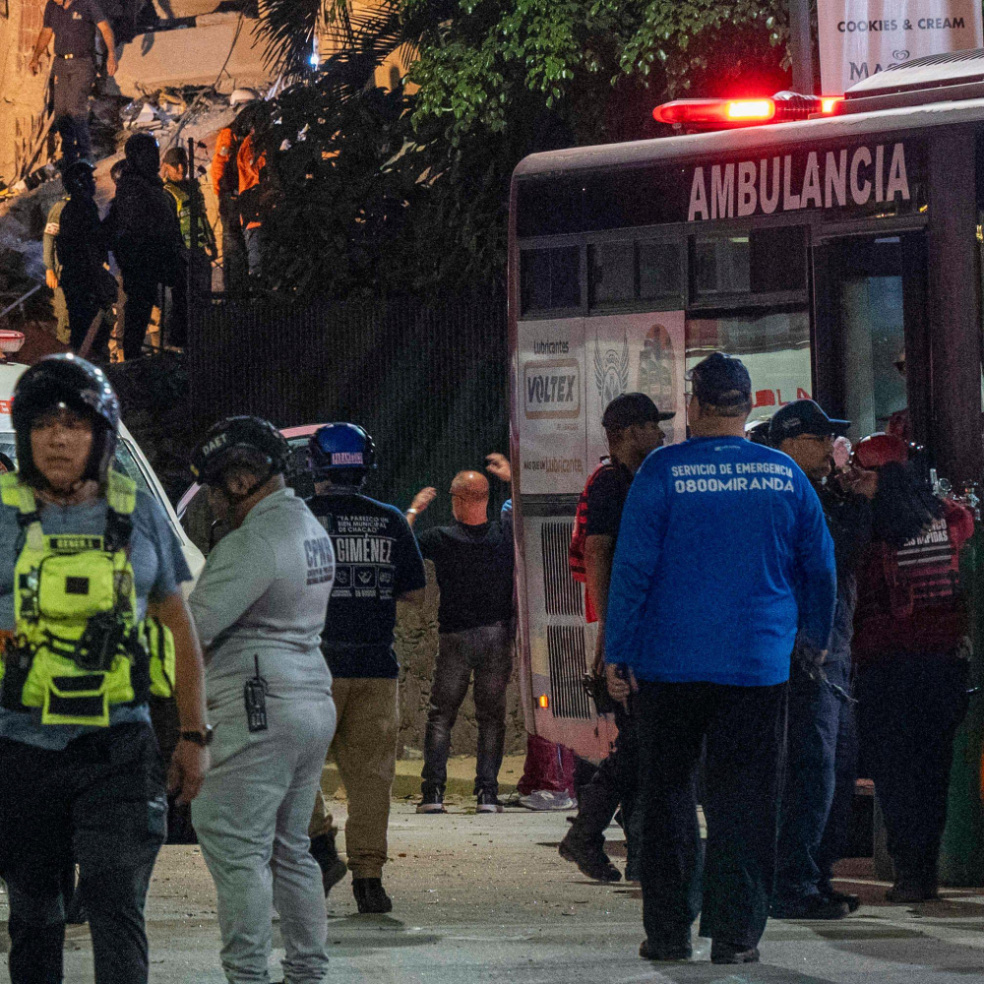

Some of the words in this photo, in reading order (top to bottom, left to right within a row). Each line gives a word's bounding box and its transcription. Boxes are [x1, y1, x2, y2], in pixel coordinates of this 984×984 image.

[837, 19, 898, 33] COOKIES
[902, 18, 913, 31] &
[917, 17, 965, 30] CREAM
[687, 142, 911, 222] AMBULANCIA
[534, 339, 569, 355] Lubricantes
[527, 374, 576, 404] VOLTEX
[671, 463, 716, 477] SERVICIO
[719, 463, 733, 475] DE
[735, 462, 793, 478] EMERGENCIA
[675, 477, 795, 494] 0800MIRANDA
[336, 533, 393, 564] GIMÉNEZ
